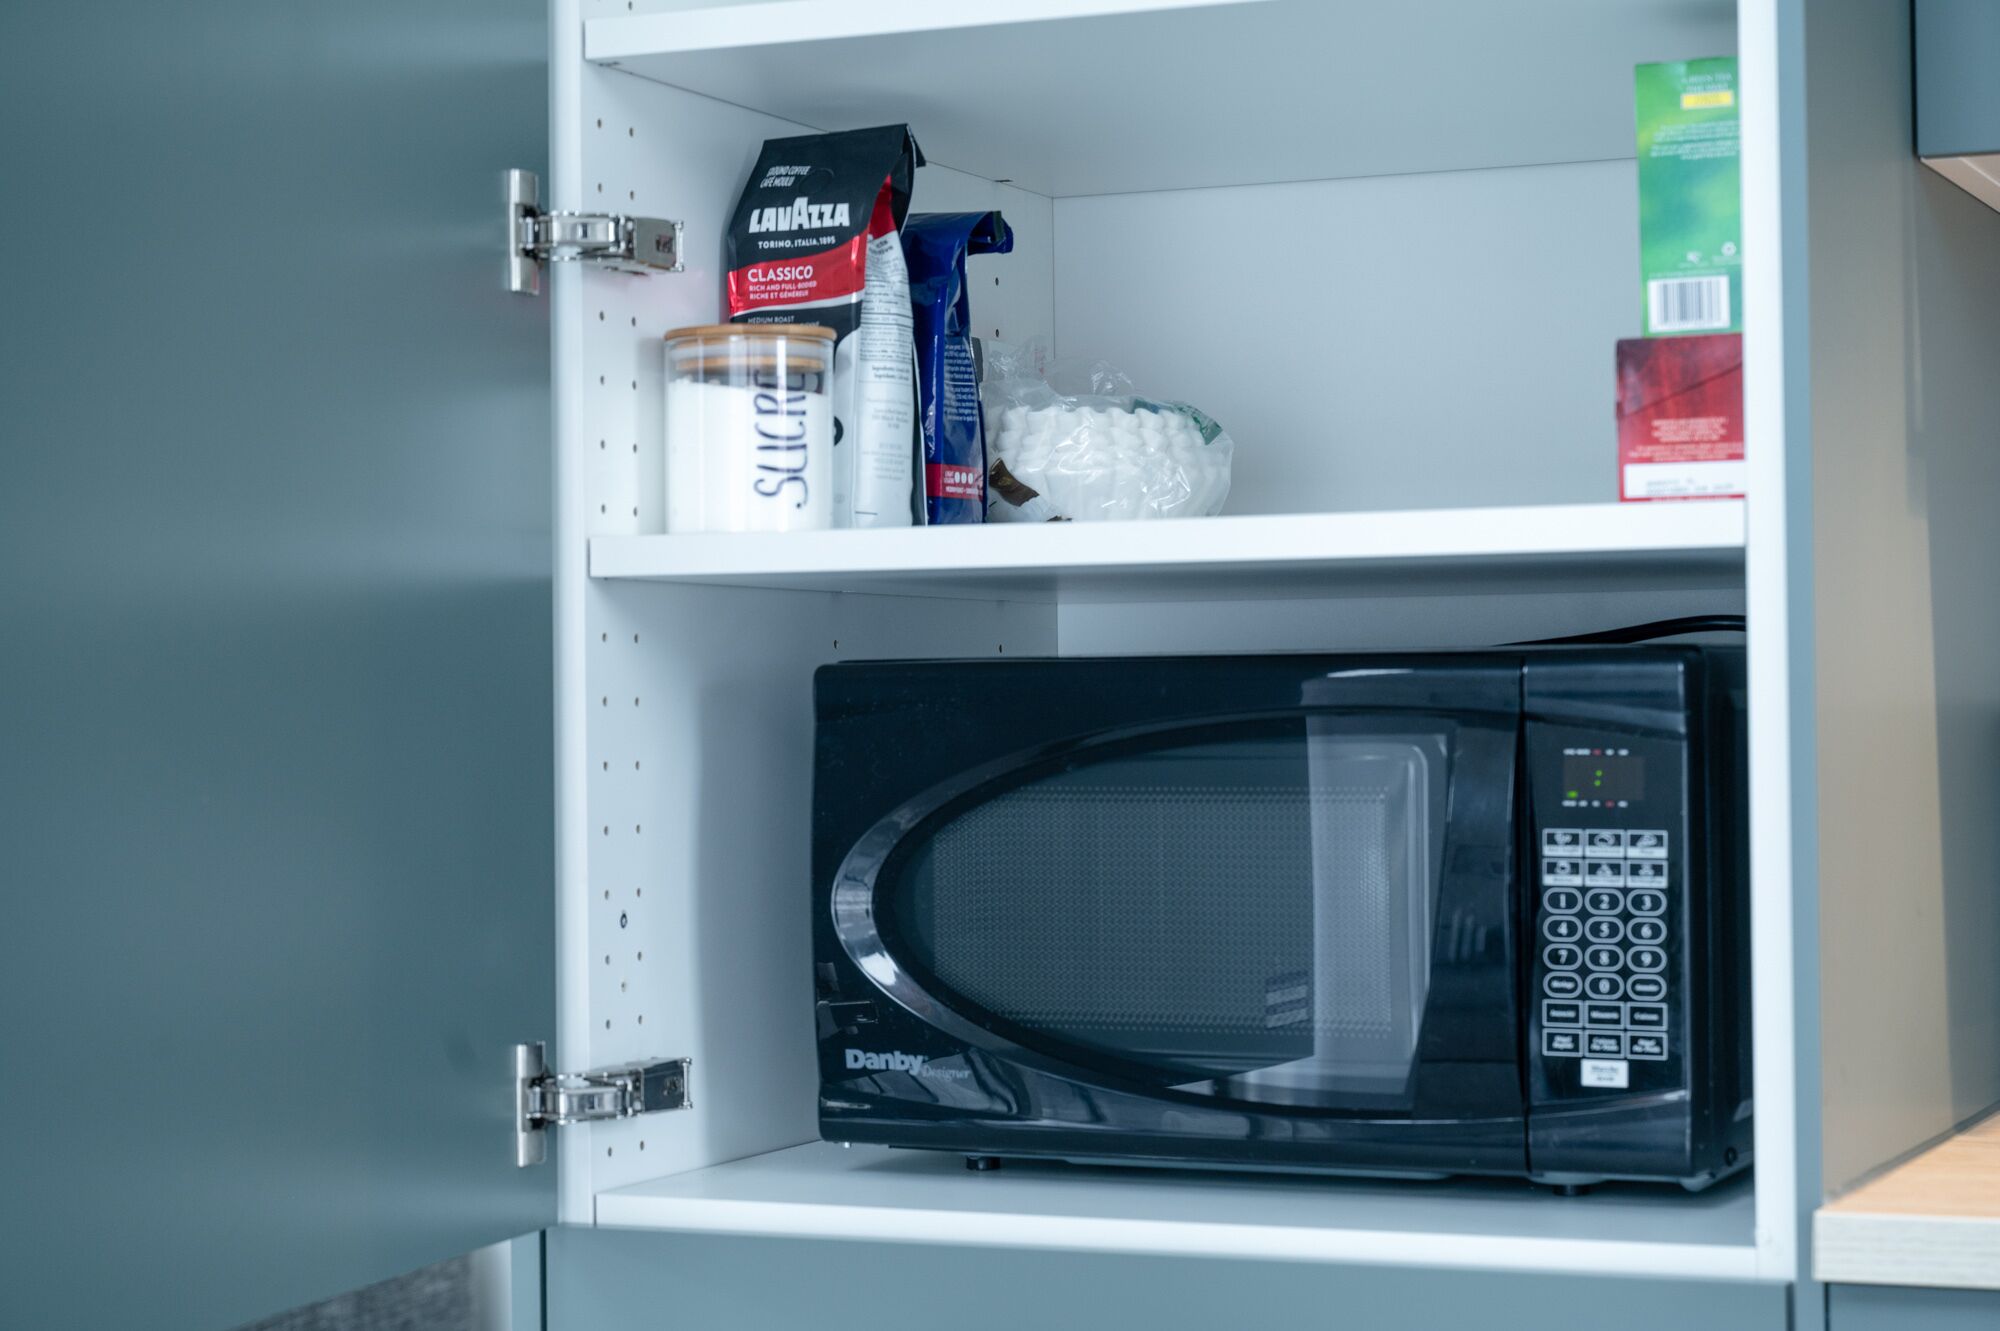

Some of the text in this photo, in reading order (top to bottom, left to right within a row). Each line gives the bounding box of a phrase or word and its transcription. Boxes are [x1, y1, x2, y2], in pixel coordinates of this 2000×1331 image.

[749, 197, 850, 233] LAVAZZA
[748, 265, 814, 283] CLASSICO
[749, 292, 768, 300] RICHE
[774, 315, 795, 323] ROAST
[1559, 893, 1652, 911] 1 2 3
[1557, 921, 1652, 939] 4 5 6
[1557, 949, 1652, 967] 7 8 9
[1599, 978, 1610, 994] 0
[845, 1049, 924, 1076] Danby
